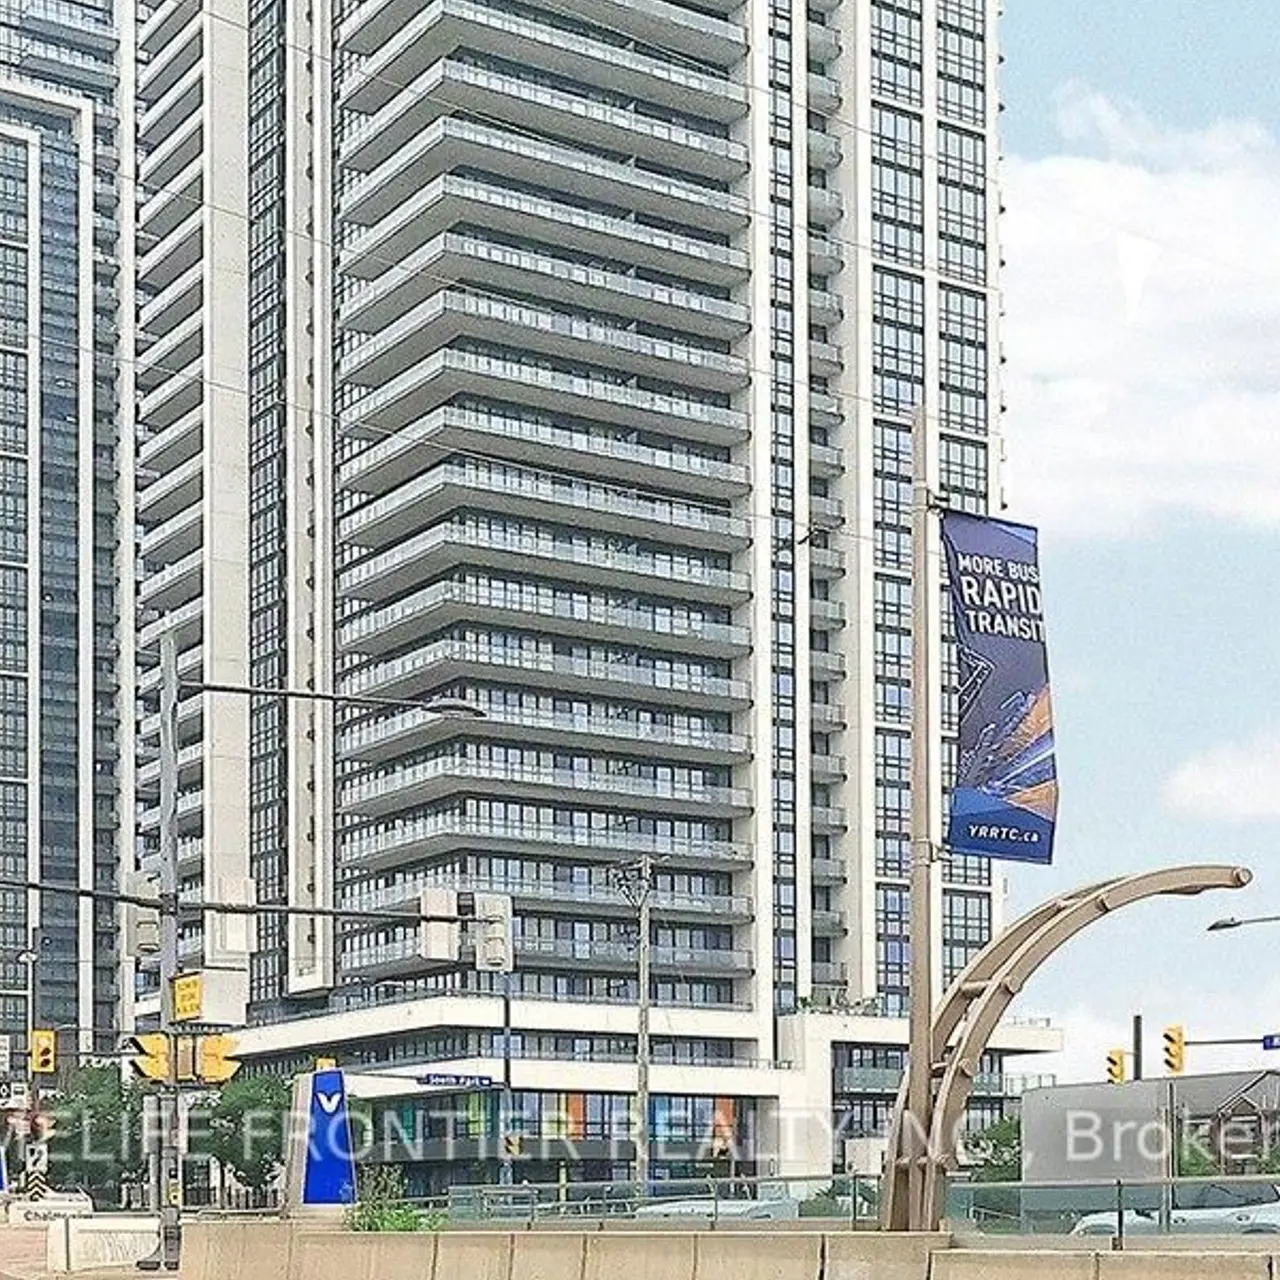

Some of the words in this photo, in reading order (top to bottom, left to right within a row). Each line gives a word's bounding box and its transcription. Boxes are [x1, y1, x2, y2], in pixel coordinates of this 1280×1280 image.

[958, 553, 1004, 577] MORE
[1007, 561, 1039, 583] BUS
[960, 576, 1041, 614] RAPID
[965, 610, 1045, 641] TRANSIT
[968, 824, 1039, 842] YRRTC.ca
